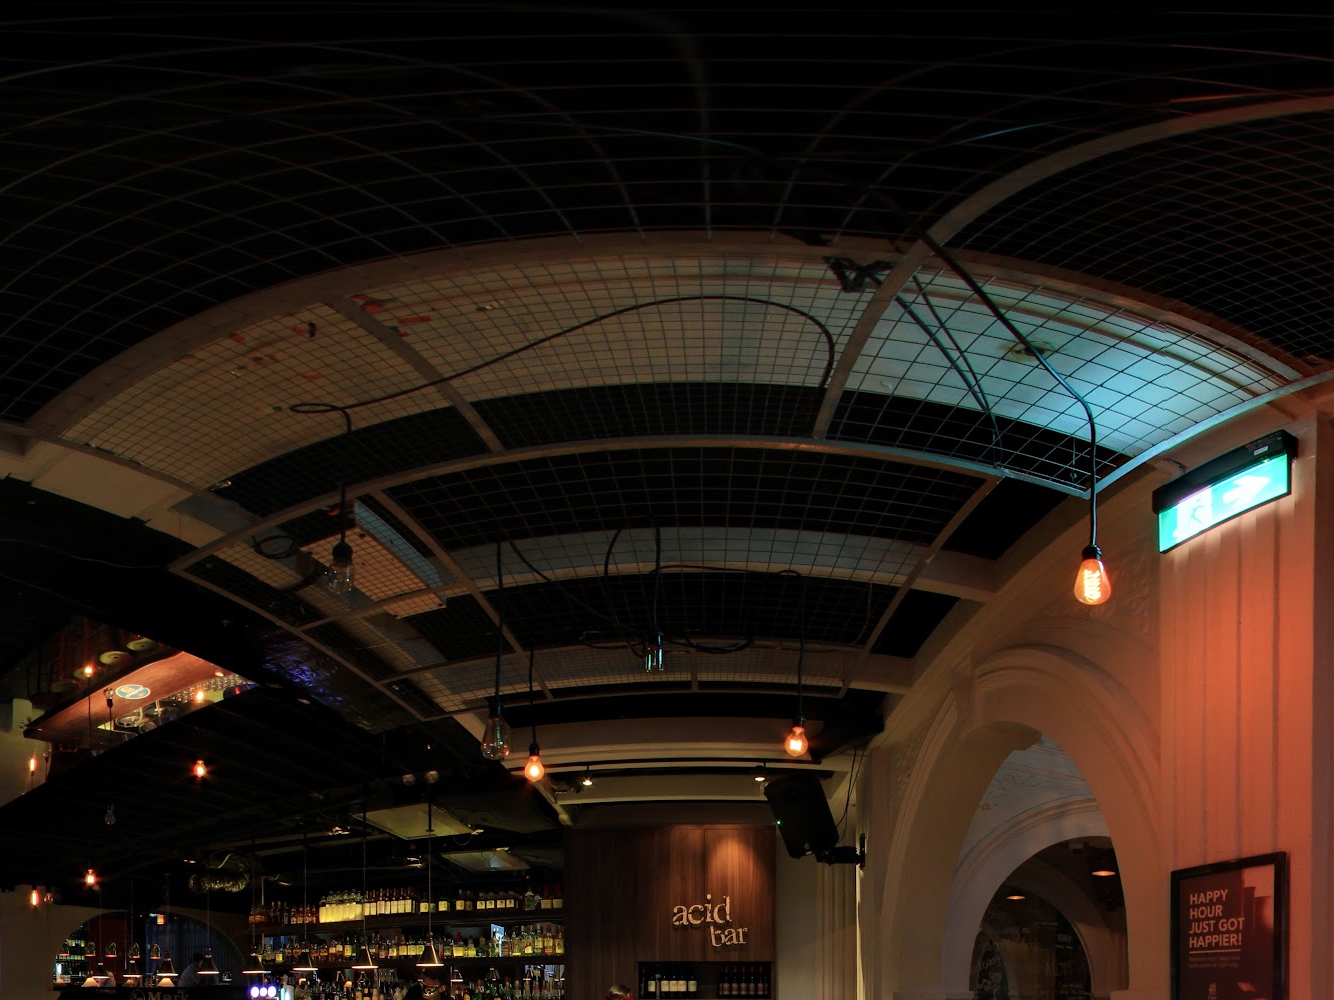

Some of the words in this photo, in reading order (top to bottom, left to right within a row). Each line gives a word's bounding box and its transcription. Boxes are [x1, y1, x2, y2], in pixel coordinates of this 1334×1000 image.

[1189, 888, 1229, 906] HAPPY
[672, 893, 733, 925] acid
[1189, 904, 1223, 920] HOUR
[1189, 920, 1216, 934] JUST
[1218, 917, 1245, 932] GOT
[709, 925, 748, 947] bar
[1189, 933, 1242, 948] HAPPIER!
